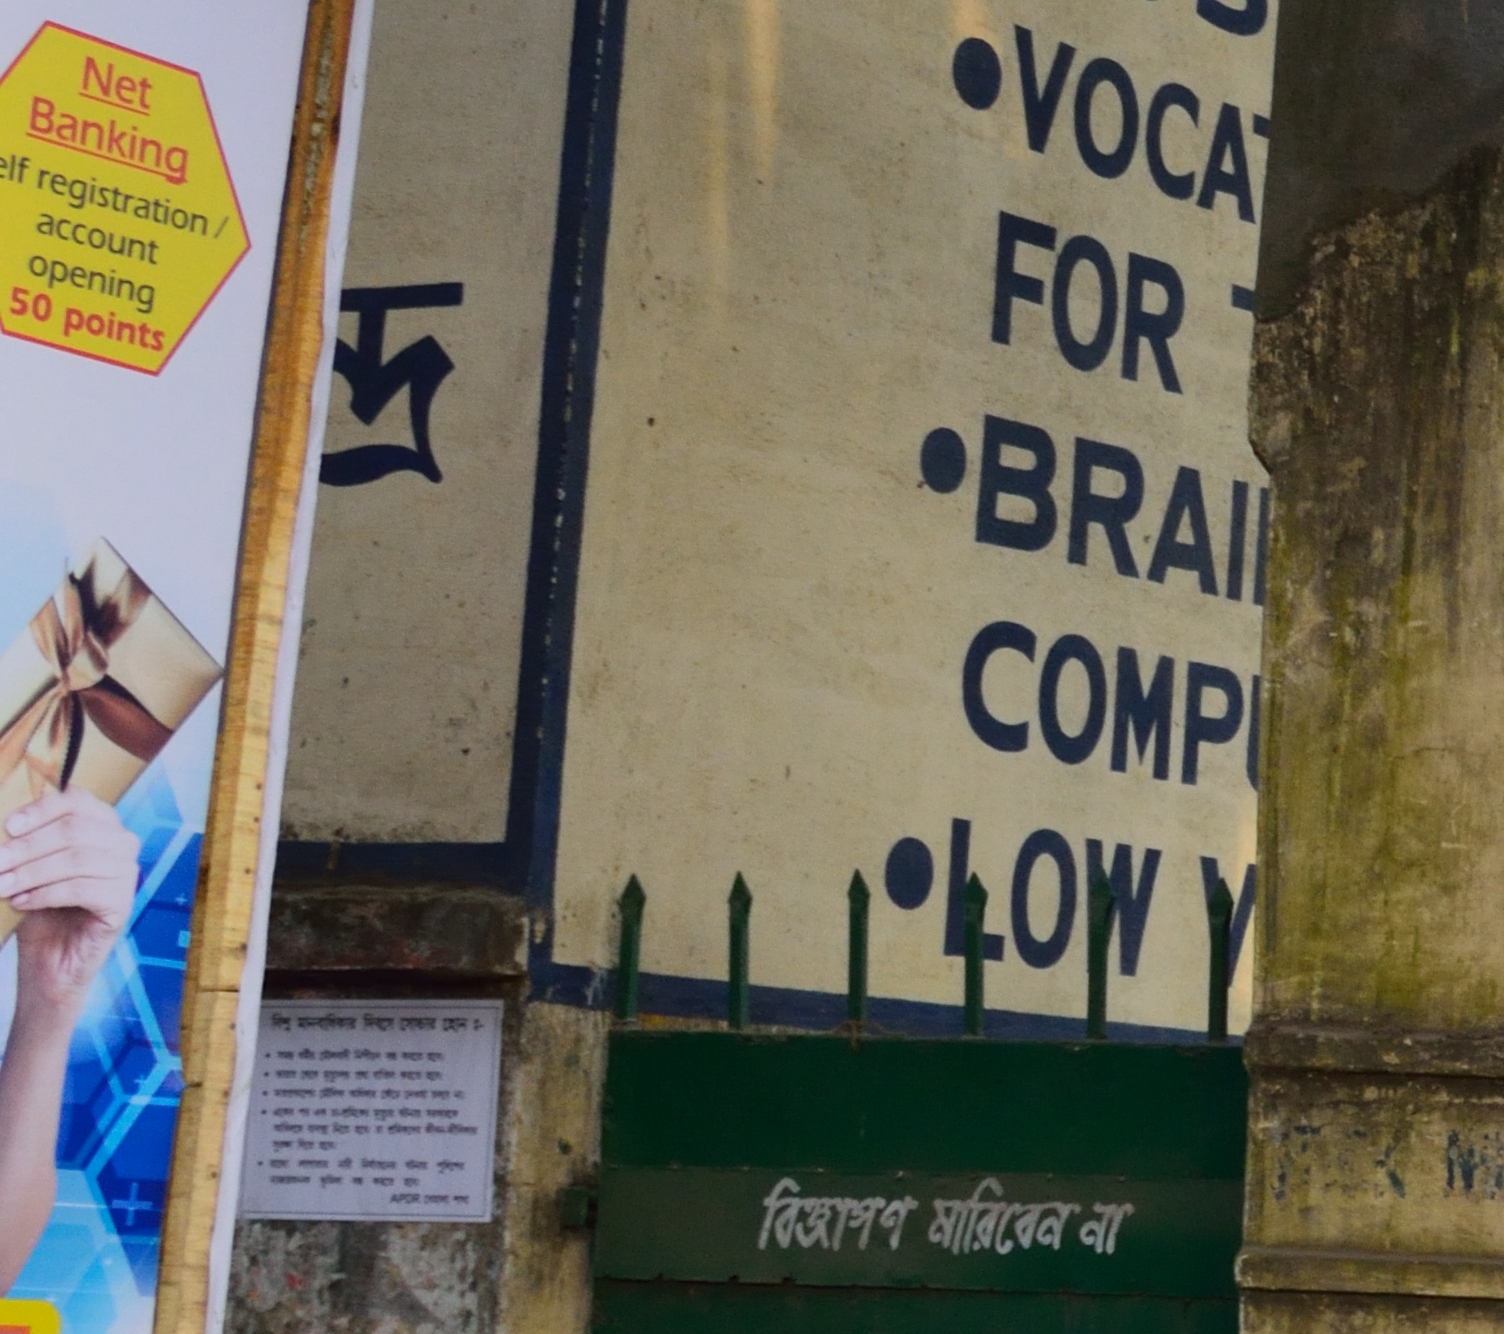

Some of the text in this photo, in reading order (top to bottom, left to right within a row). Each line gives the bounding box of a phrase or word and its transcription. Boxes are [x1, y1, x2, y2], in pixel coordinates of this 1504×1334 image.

[81, 55, 153, 111] Net
[28, 96, 189, 185] Banking
[1013, 24, 1271, 225] VOCA
[36, 167, 209, 235] registration
[36, 213, 159, 265] account
[28, 254, 155, 314] opening
[990, 210, 1186, 395] FOR
[10, 286, 164, 352] 50 points
[942, 817, 1161, 977] LOW
[1080, 1203, 1135, 1255] না
